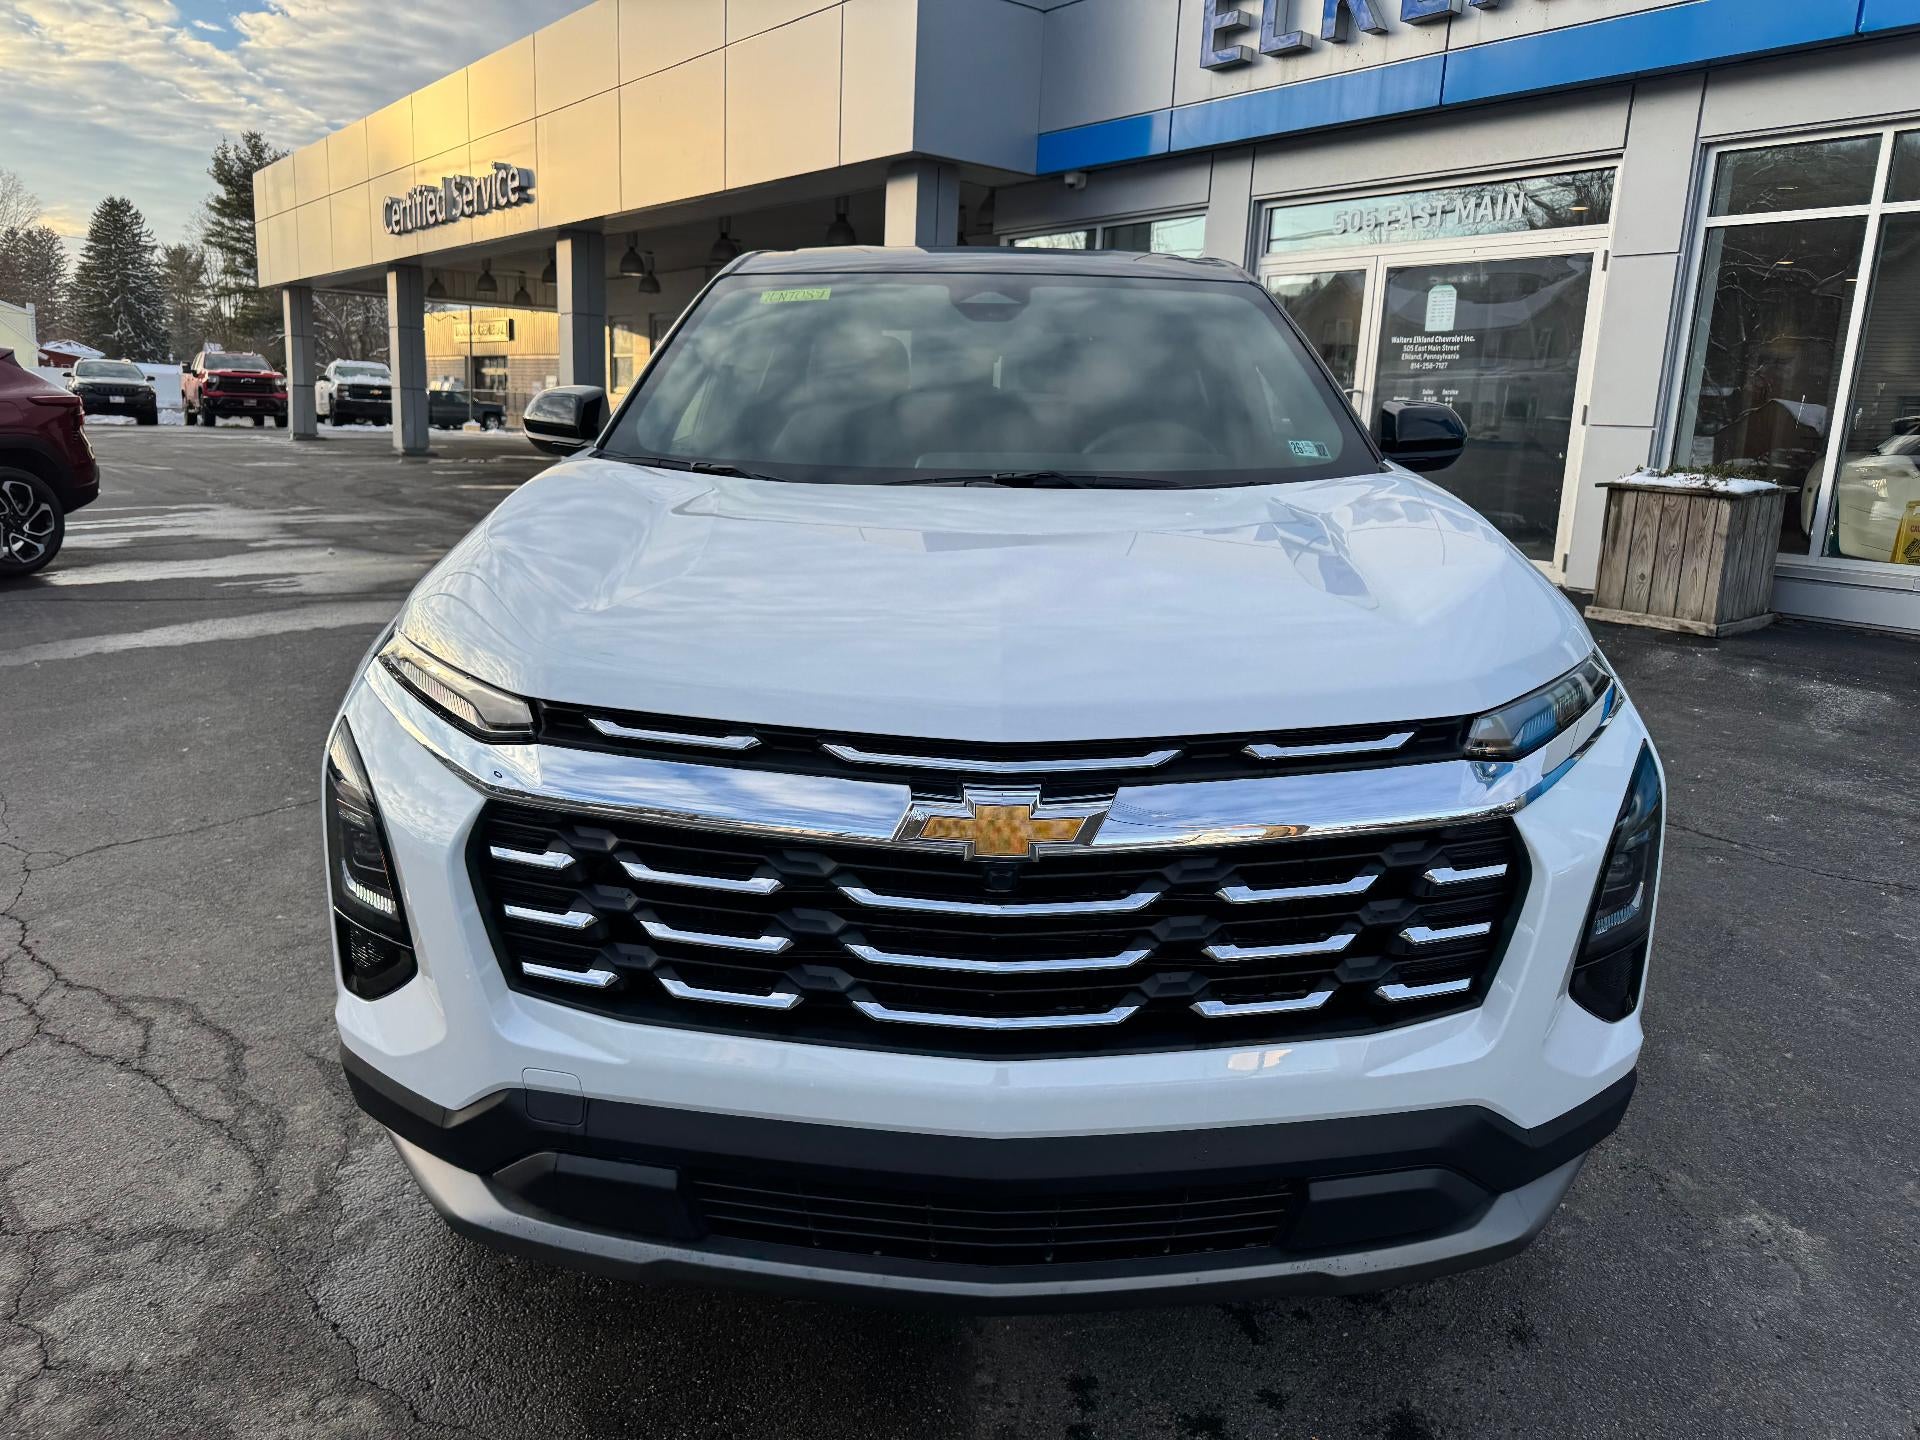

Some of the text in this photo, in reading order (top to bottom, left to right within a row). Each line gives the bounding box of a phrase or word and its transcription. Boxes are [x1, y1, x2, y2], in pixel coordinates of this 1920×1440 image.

[383, 161, 521, 234] Certified Service
[1333, 191, 1525, 234] 505 EAST MAIN
[1464, 334, 1476, 342] Inc.
[1423, 353, 1460, 361] Pennsylvania
